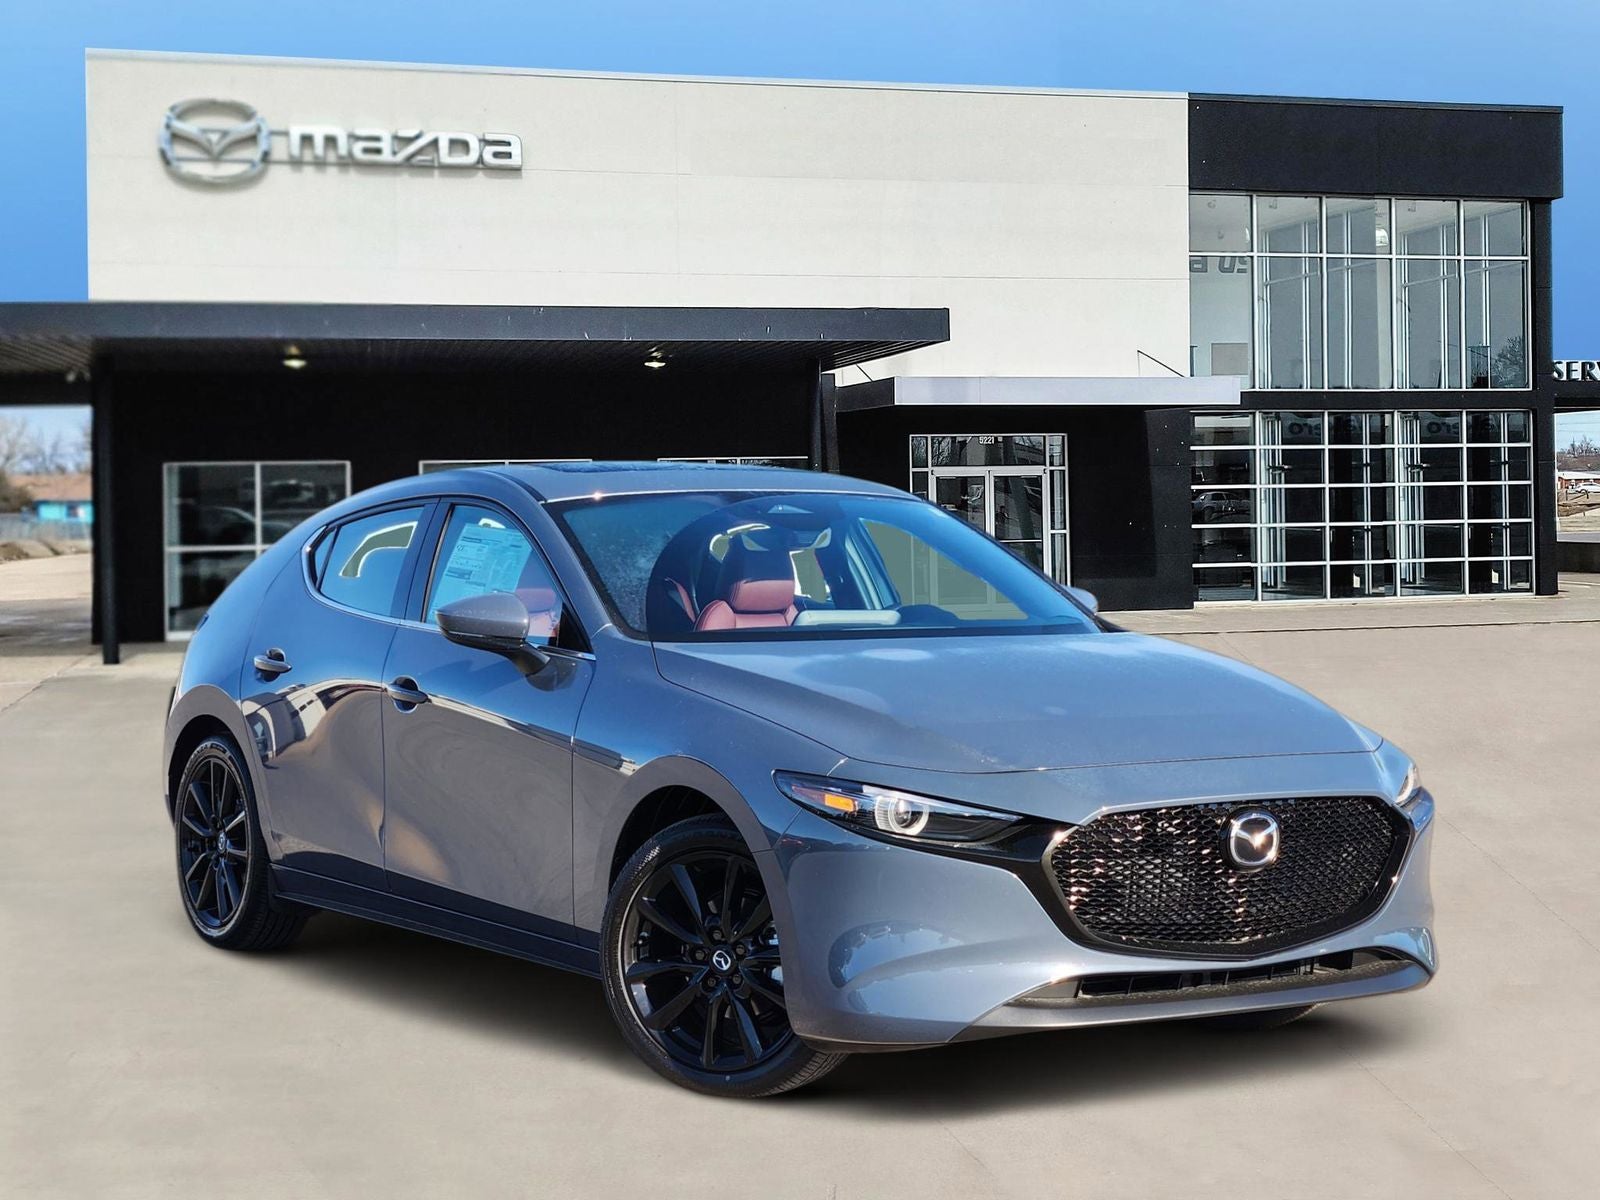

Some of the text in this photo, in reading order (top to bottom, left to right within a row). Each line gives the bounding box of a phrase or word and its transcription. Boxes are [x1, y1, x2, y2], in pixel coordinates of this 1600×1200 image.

[288, 124, 523, 170] mazda
[1552, 360, 1600, 381] SER
[979, 436, 995, 445] 5221
